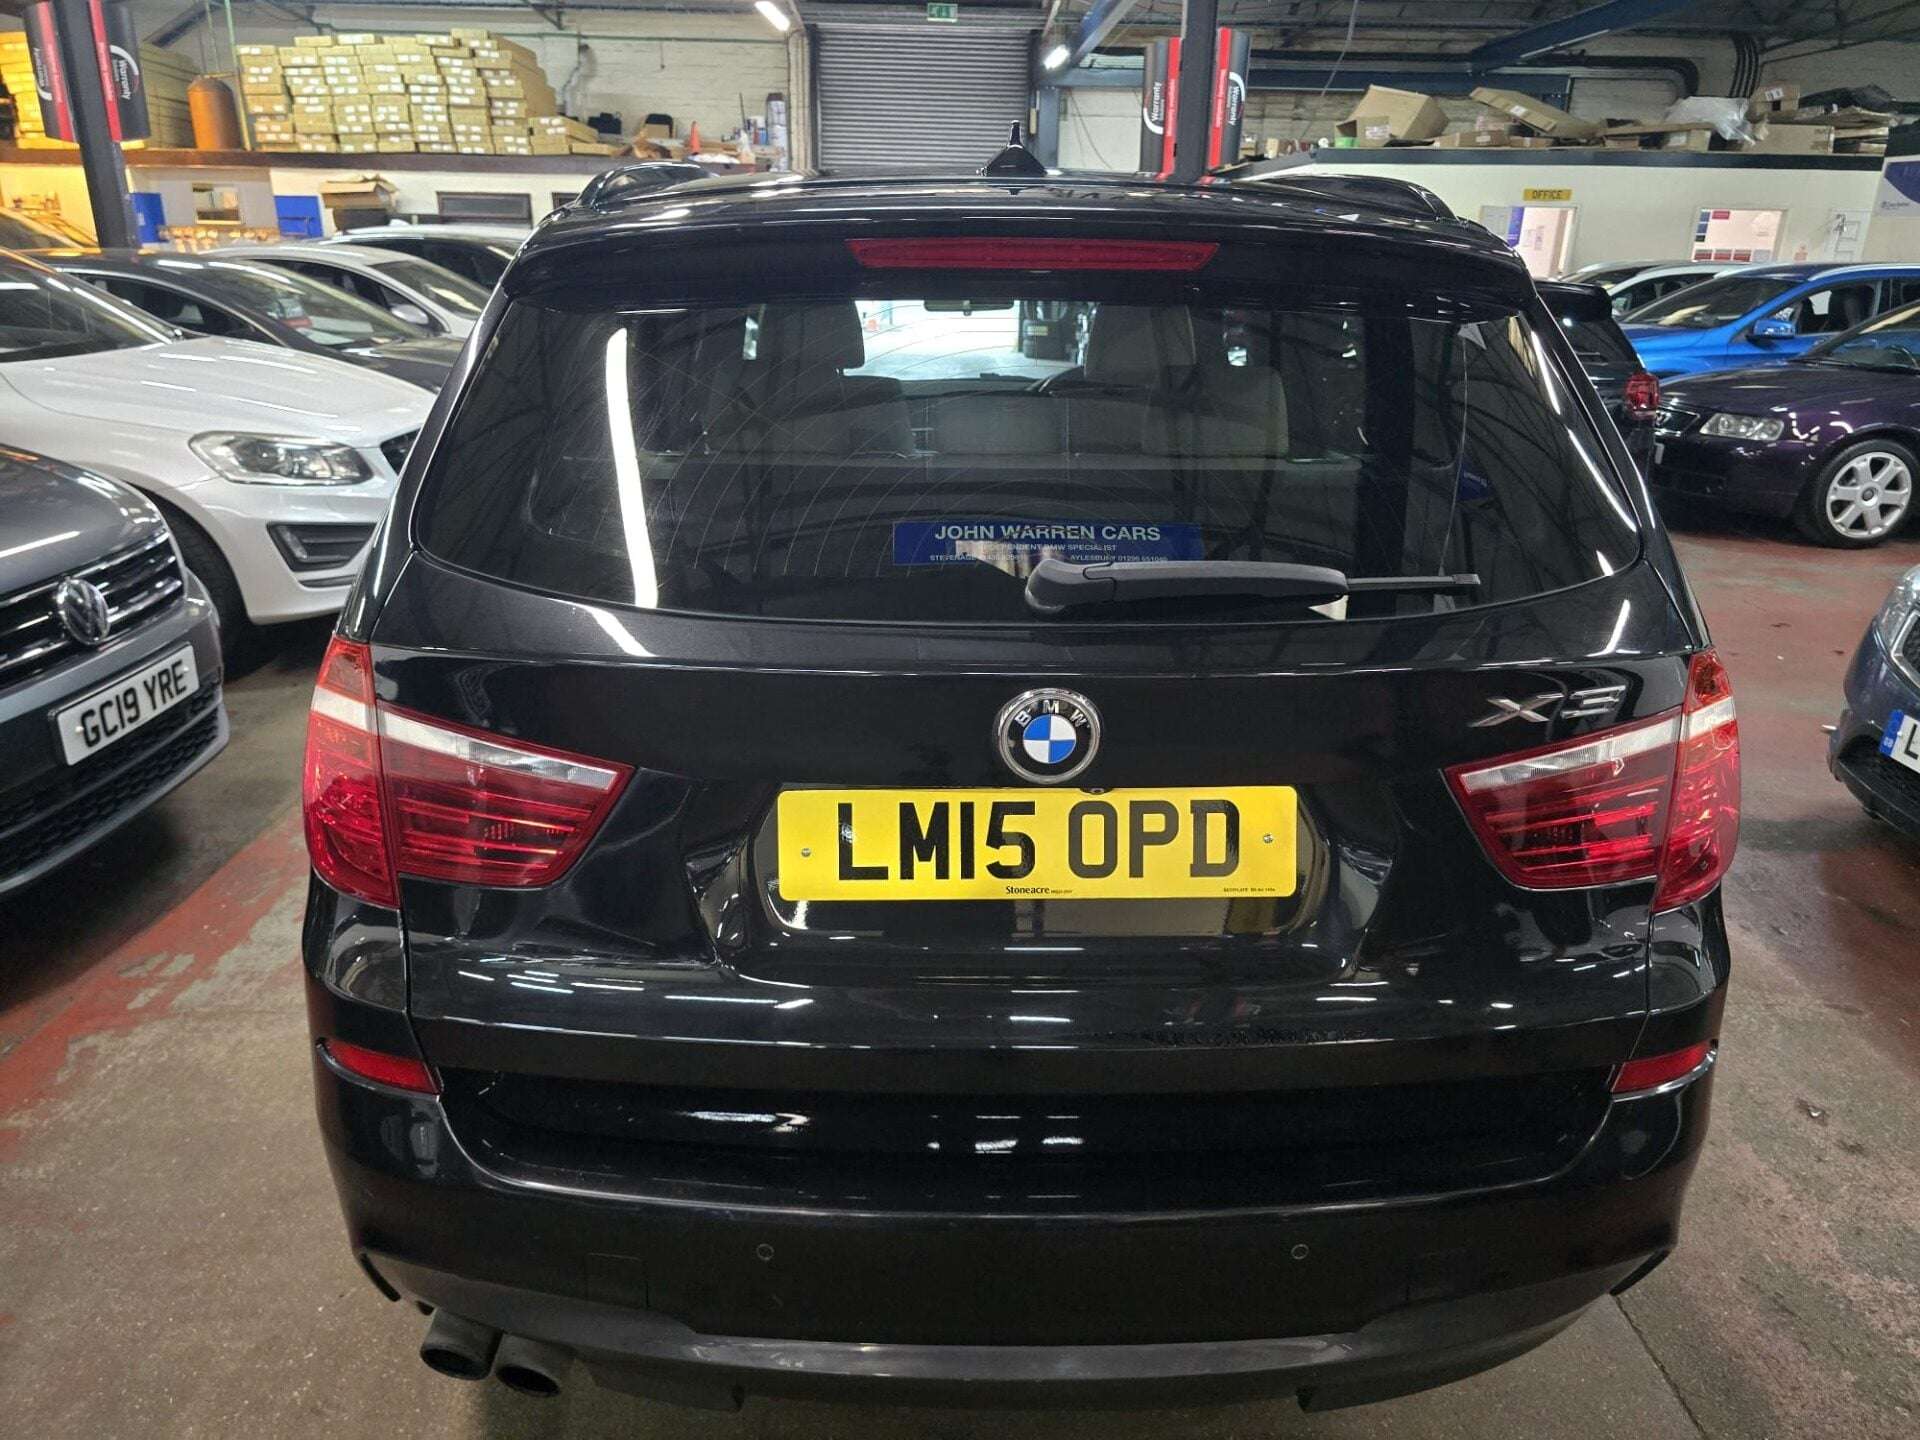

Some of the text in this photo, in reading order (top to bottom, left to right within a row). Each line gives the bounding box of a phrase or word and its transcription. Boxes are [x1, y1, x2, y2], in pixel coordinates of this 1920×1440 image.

[1151, 81, 1163, 122] Warranty
[1228, 86, 1240, 126] Warranty
[1531, 189, 1564, 200] OFFICE
[934, 525, 1161, 541] JOHN WARREN CARS
[1067, 543, 1117, 551] SPECIALIST
[81, 659, 188, 748] GC19 YRE
[1015, 700, 1089, 728] BMW
[1467, 685, 1627, 728] X3
[837, 799, 1241, 881] LM15 OPD
[1006, 885, 1051, 895] Stoneacre
